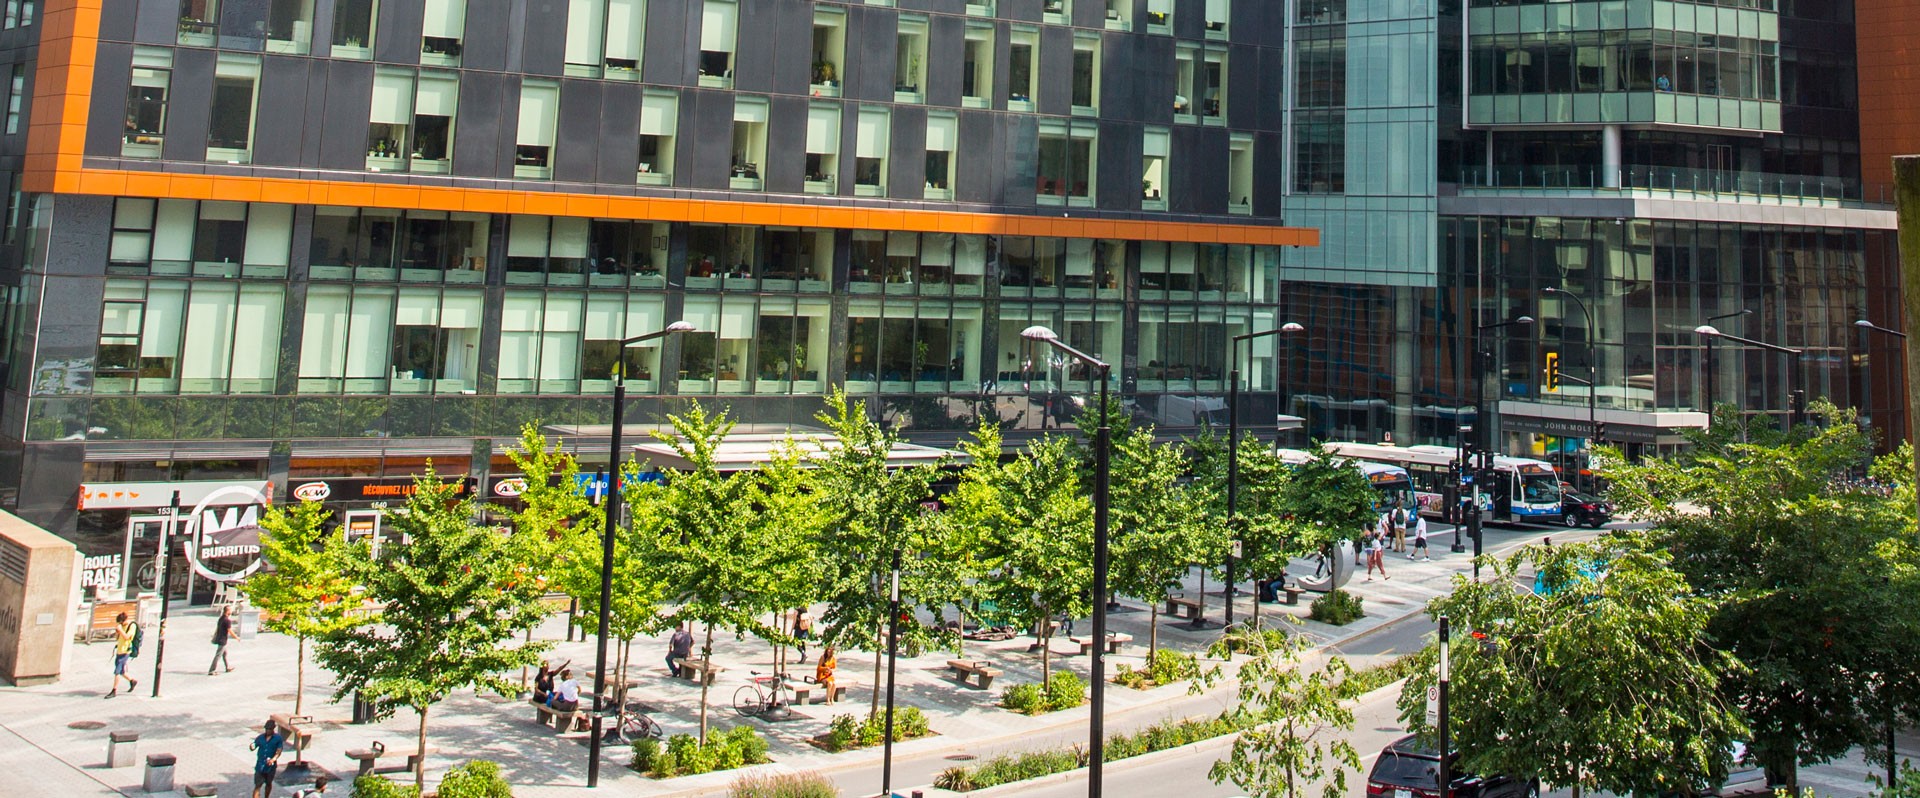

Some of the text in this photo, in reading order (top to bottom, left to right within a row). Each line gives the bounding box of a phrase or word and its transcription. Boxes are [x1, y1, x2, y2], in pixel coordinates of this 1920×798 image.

[1544, 423, 1597, 433] JOHN-MOLS
[362, 483, 401, 496] DÉCOUVREZ
[590, 481, 608, 489] BO
[202, 545, 260, 559] BURRITOS
[82, 566, 121, 587] RAIS
